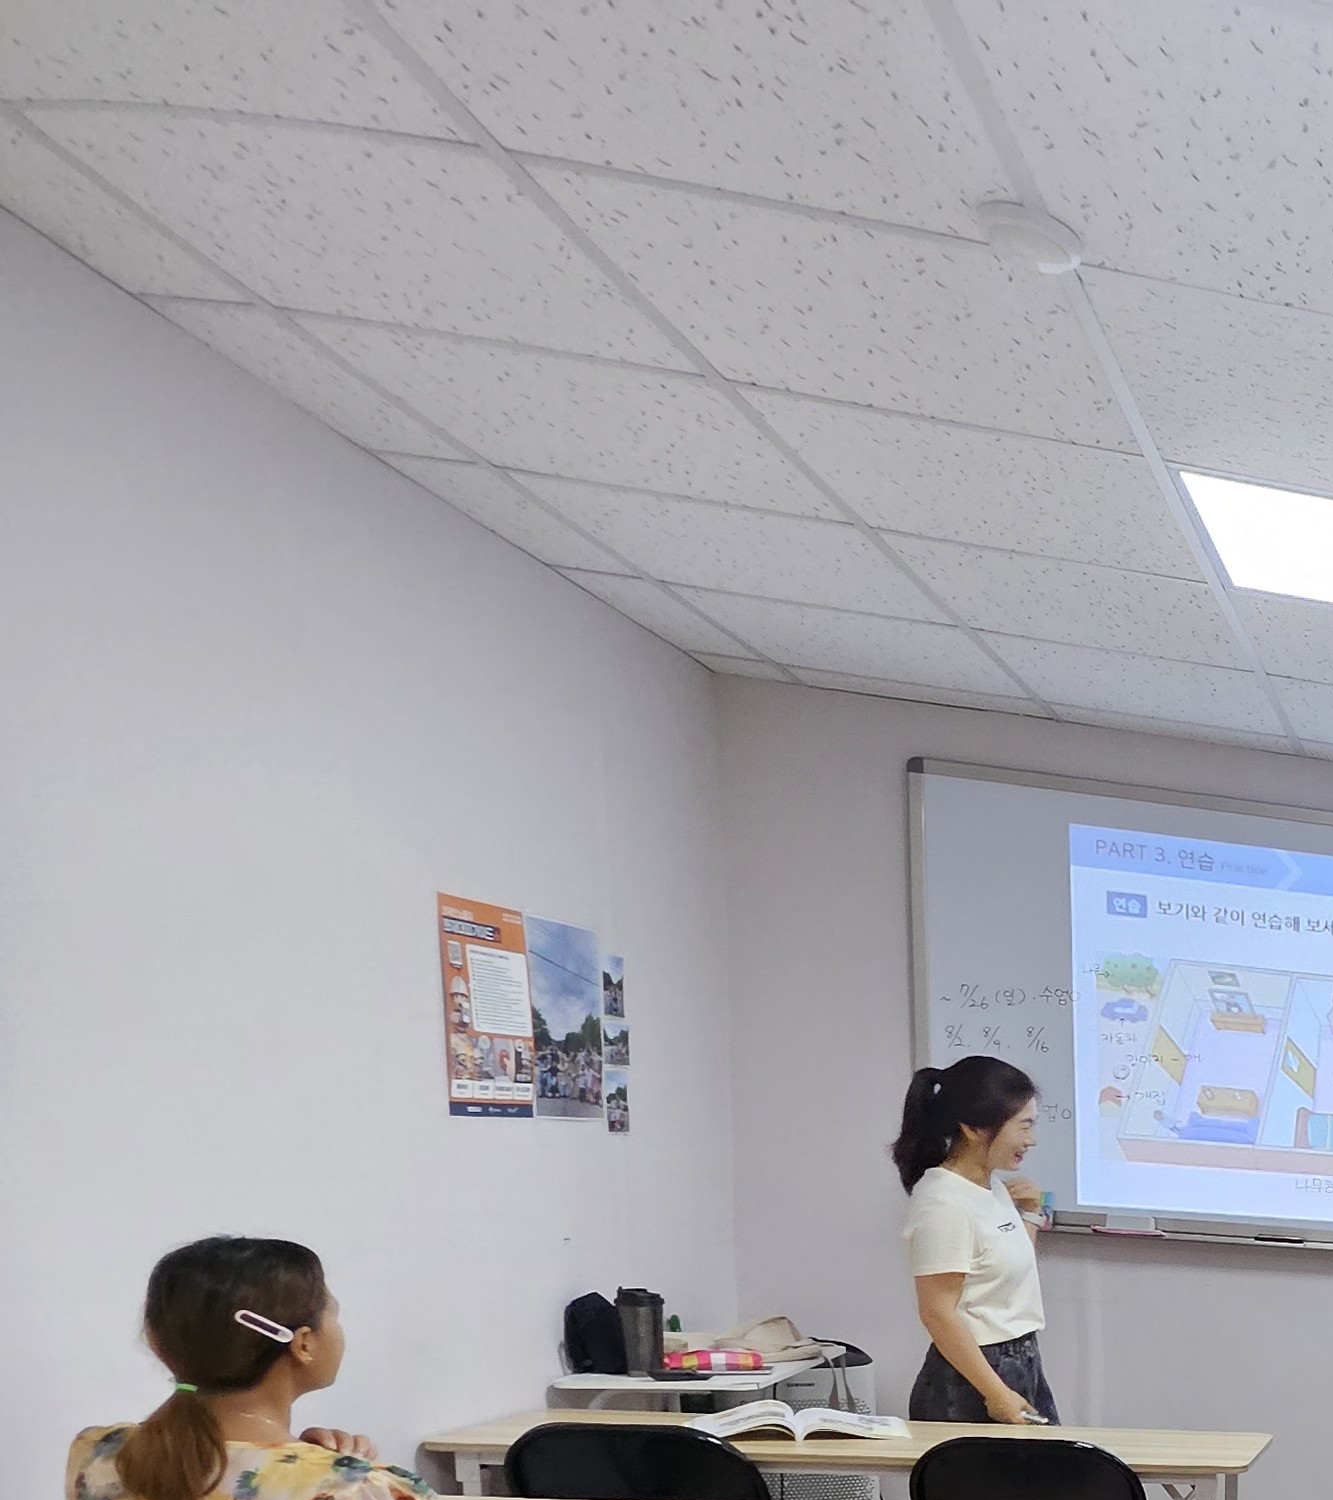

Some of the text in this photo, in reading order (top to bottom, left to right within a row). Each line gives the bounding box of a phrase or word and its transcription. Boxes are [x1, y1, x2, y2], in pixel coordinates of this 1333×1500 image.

[1096, 839, 1148, 860] PART
[1155, 847, 1171, 864] 3.
[1178, 849, 1215, 872] 연습
[1112, 896, 1142, 915] 연습
[1156, 900, 1207, 922] 보기와
[1213, 907, 1245, 926] 같이
[1252, 910, 1300, 933] 연습해
